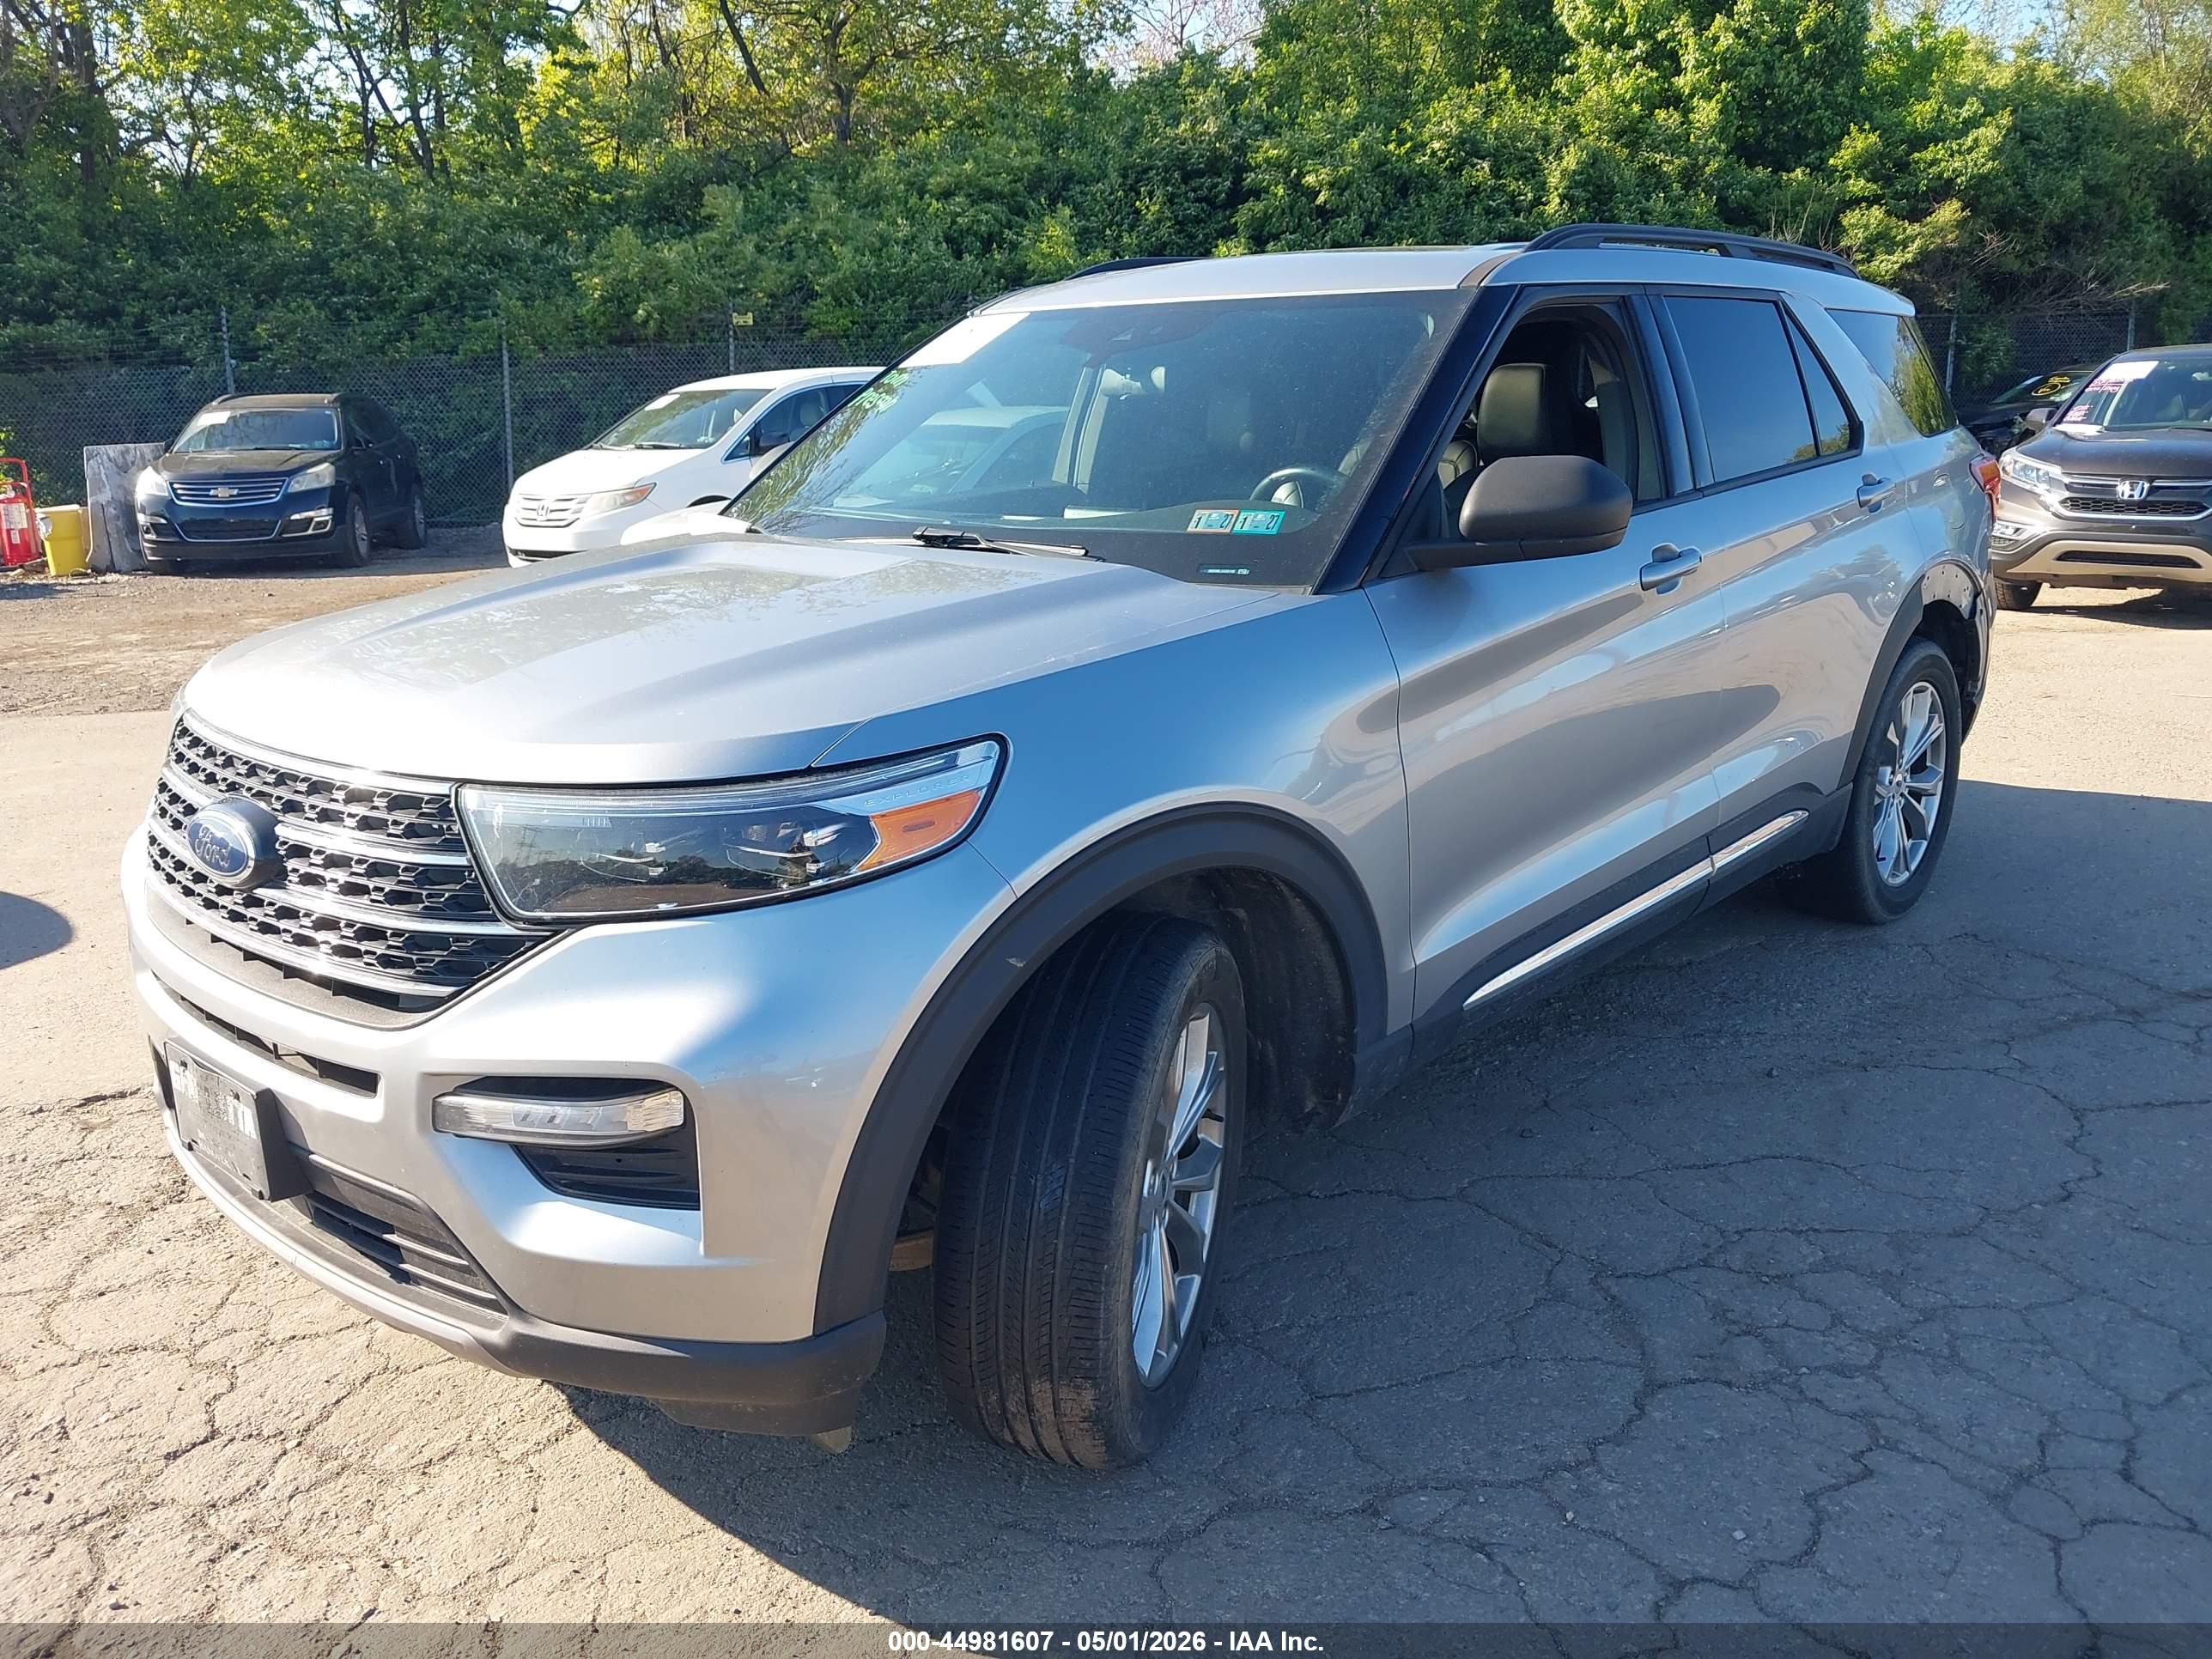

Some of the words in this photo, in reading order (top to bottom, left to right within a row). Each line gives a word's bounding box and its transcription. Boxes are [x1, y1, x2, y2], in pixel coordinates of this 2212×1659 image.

[1219, 514, 1234, 530] 27
[1266, 514, 1280, 531] 27
[864, 775, 970, 806] EXPLORER
[195, 825, 232, 868] Ford
